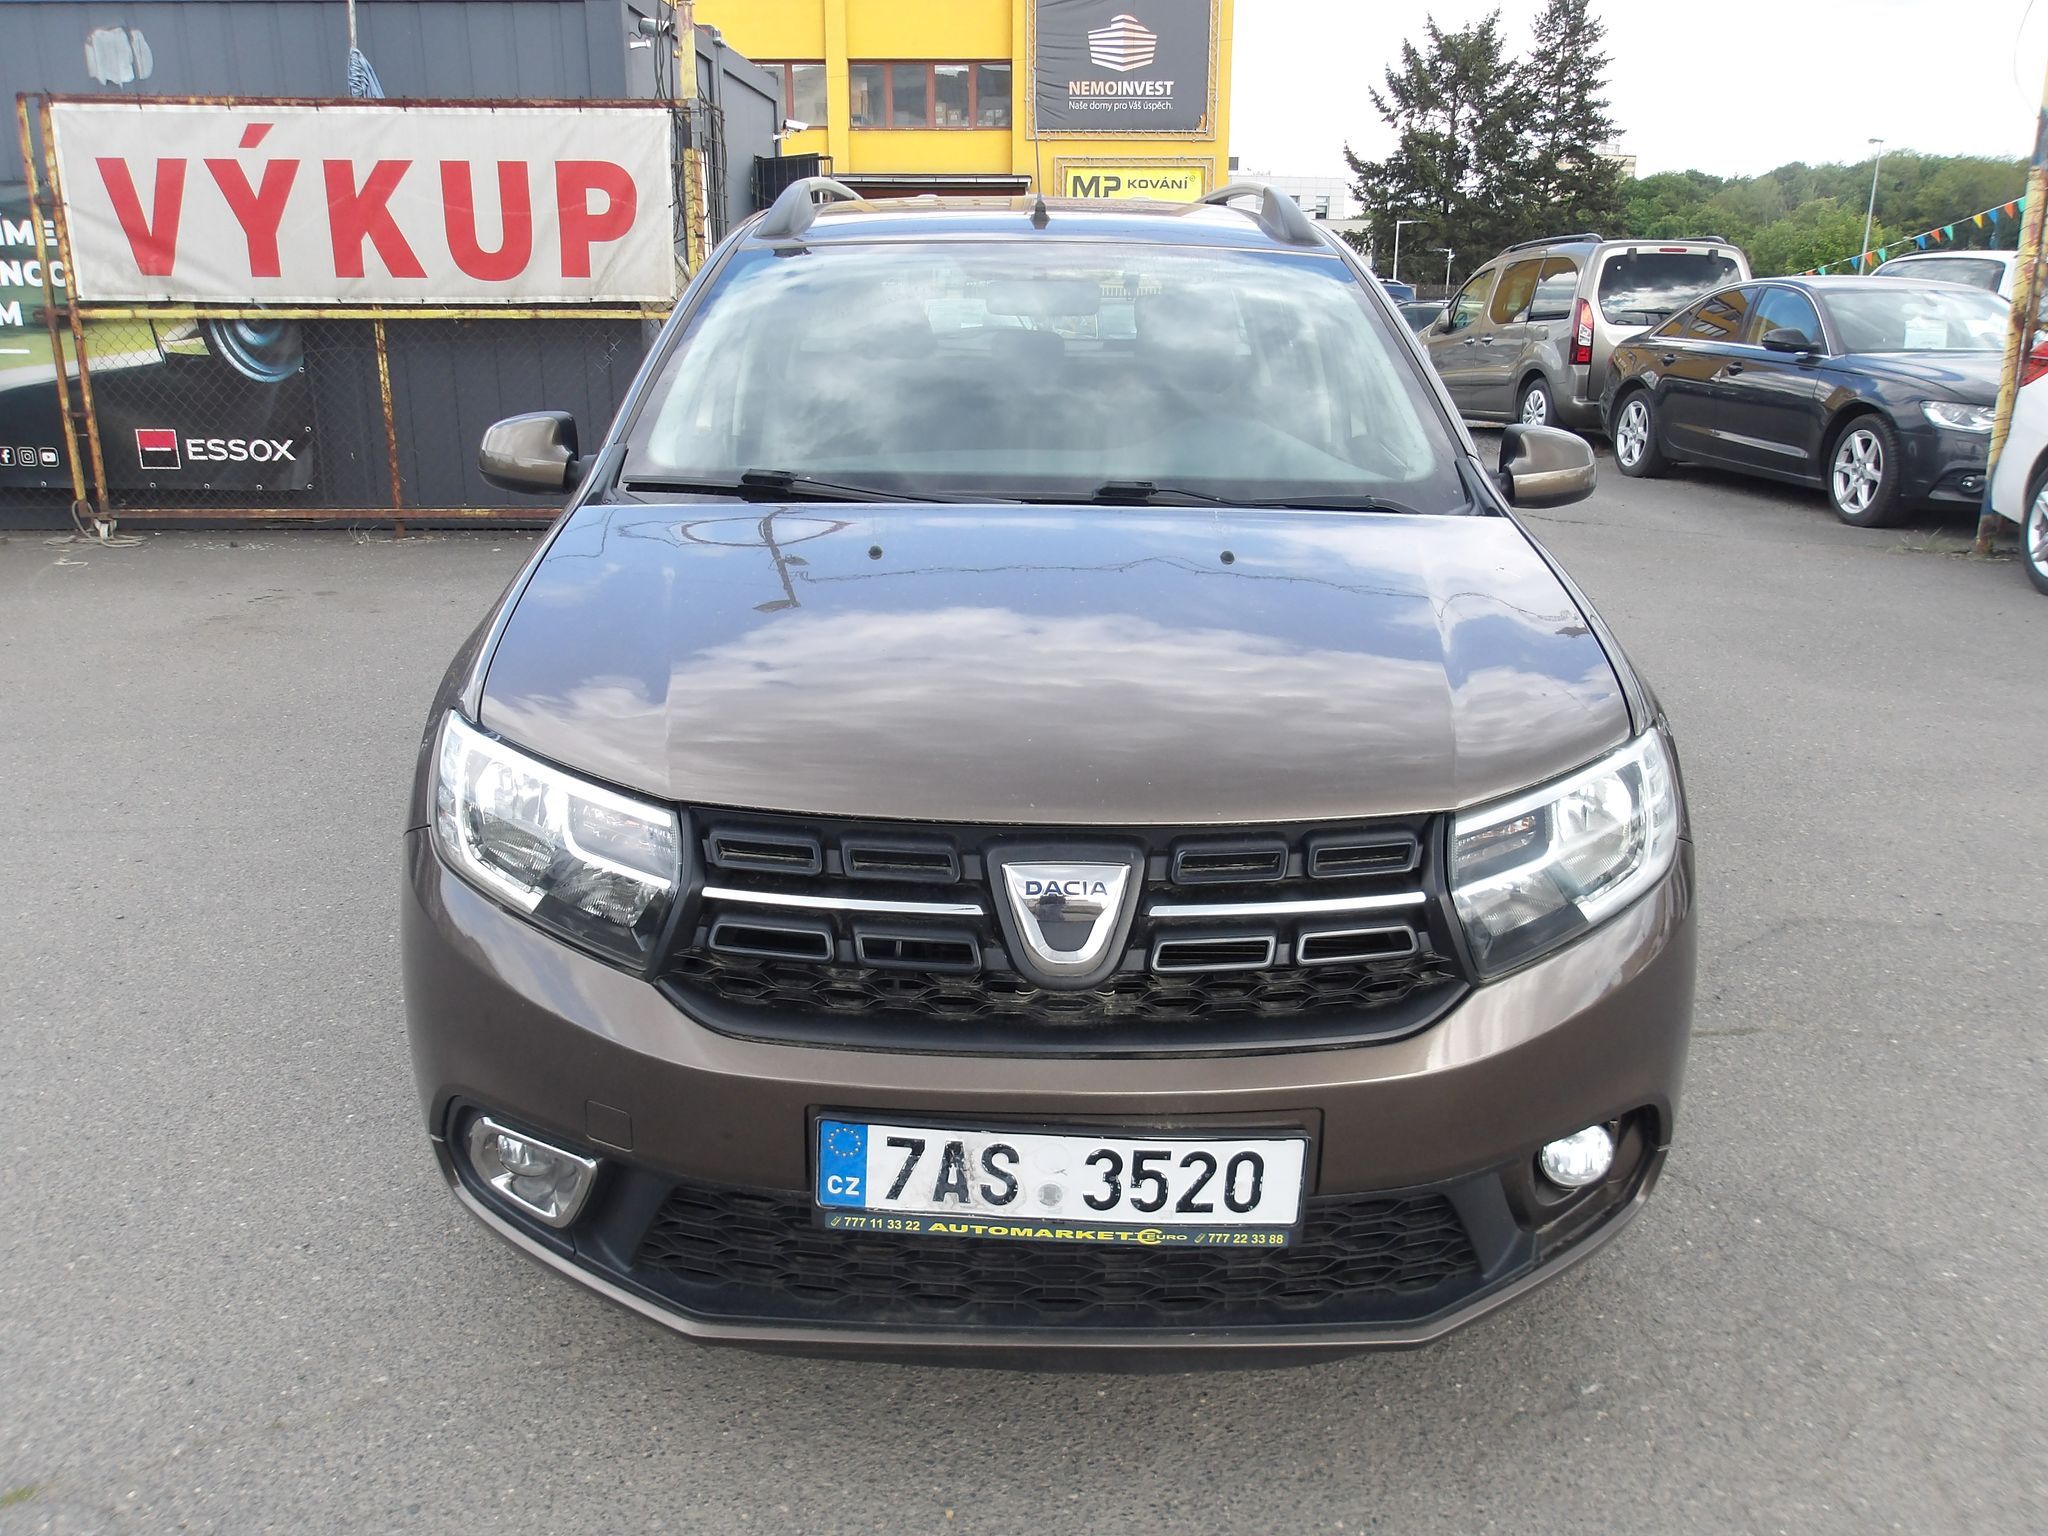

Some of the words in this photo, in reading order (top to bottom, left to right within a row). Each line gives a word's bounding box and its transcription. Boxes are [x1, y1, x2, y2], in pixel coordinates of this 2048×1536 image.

[1069, 81, 1174, 95] NEMOINVEST
[1069, 100, 1088, 110] Naše
[1089, 101, 1113, 112] domy
[1114, 102, 1127, 112] pro
[1129, 100, 1141, 110] Váš
[1143, 100, 1174, 112] úspěch.
[1072, 175, 1121, 198] MP
[96, 123, 637, 282] VÝKUP
[186, 439, 296, 462] ESSOX
[1025, 881, 1108, 895] DACIA
[827, 1175, 860, 1196] CZ
[885, 1136, 1020, 1206] 7AS
[1082, 1148, 1265, 1214] 3520
[844, 1217, 866, 1228] 777
[870, 1218, 883, 1229] 11
[887, 1219, 902, 1230] 33
[905, 1220, 920, 1231] 22
[1208, 1233, 1230, 1243] 777
[1233, 1233, 1247, 1244] 22
[1251, 1234, 1265, 1244] 33
[1268, 1234, 1284, 1245] 88
